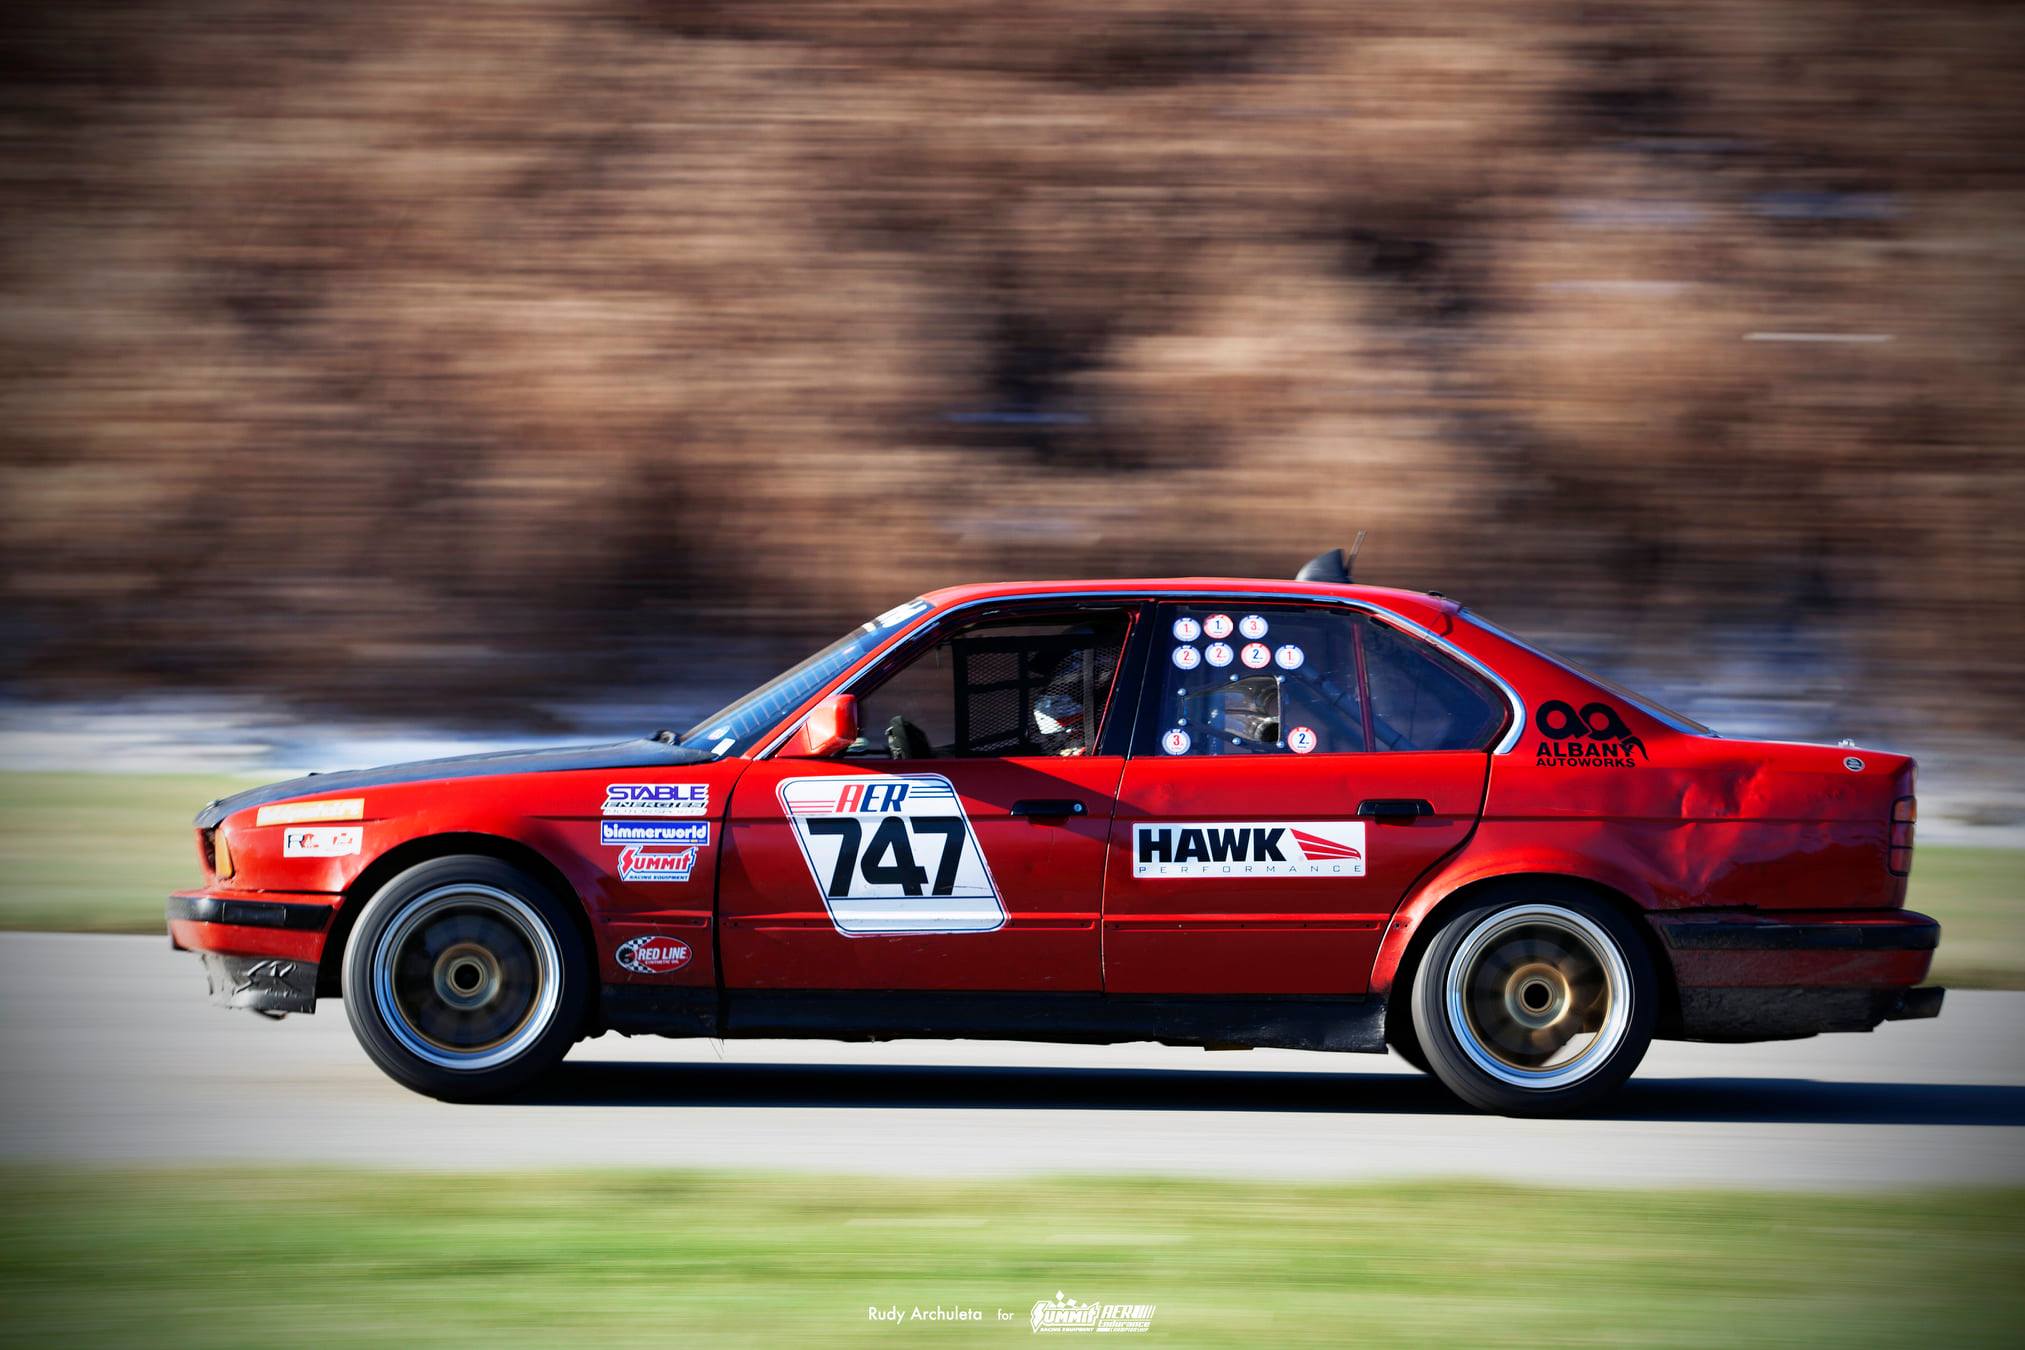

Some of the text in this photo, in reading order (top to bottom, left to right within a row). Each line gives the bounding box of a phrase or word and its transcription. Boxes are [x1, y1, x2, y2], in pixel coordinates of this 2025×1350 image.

[1536, 742, 1634, 757] ALBANY
[1536, 758, 1636, 768] AUTOWORKS
[608, 786, 706, 800] STABLE
[835, 784, 910, 812] AER
[603, 823, 707, 839] bimmerworld
[1138, 828, 1287, 863] HAWK
[806, 816, 966, 897] 747
[1138, 865, 1361, 873] PERFORMANCE
[638, 947, 687, 960] RED LINE
